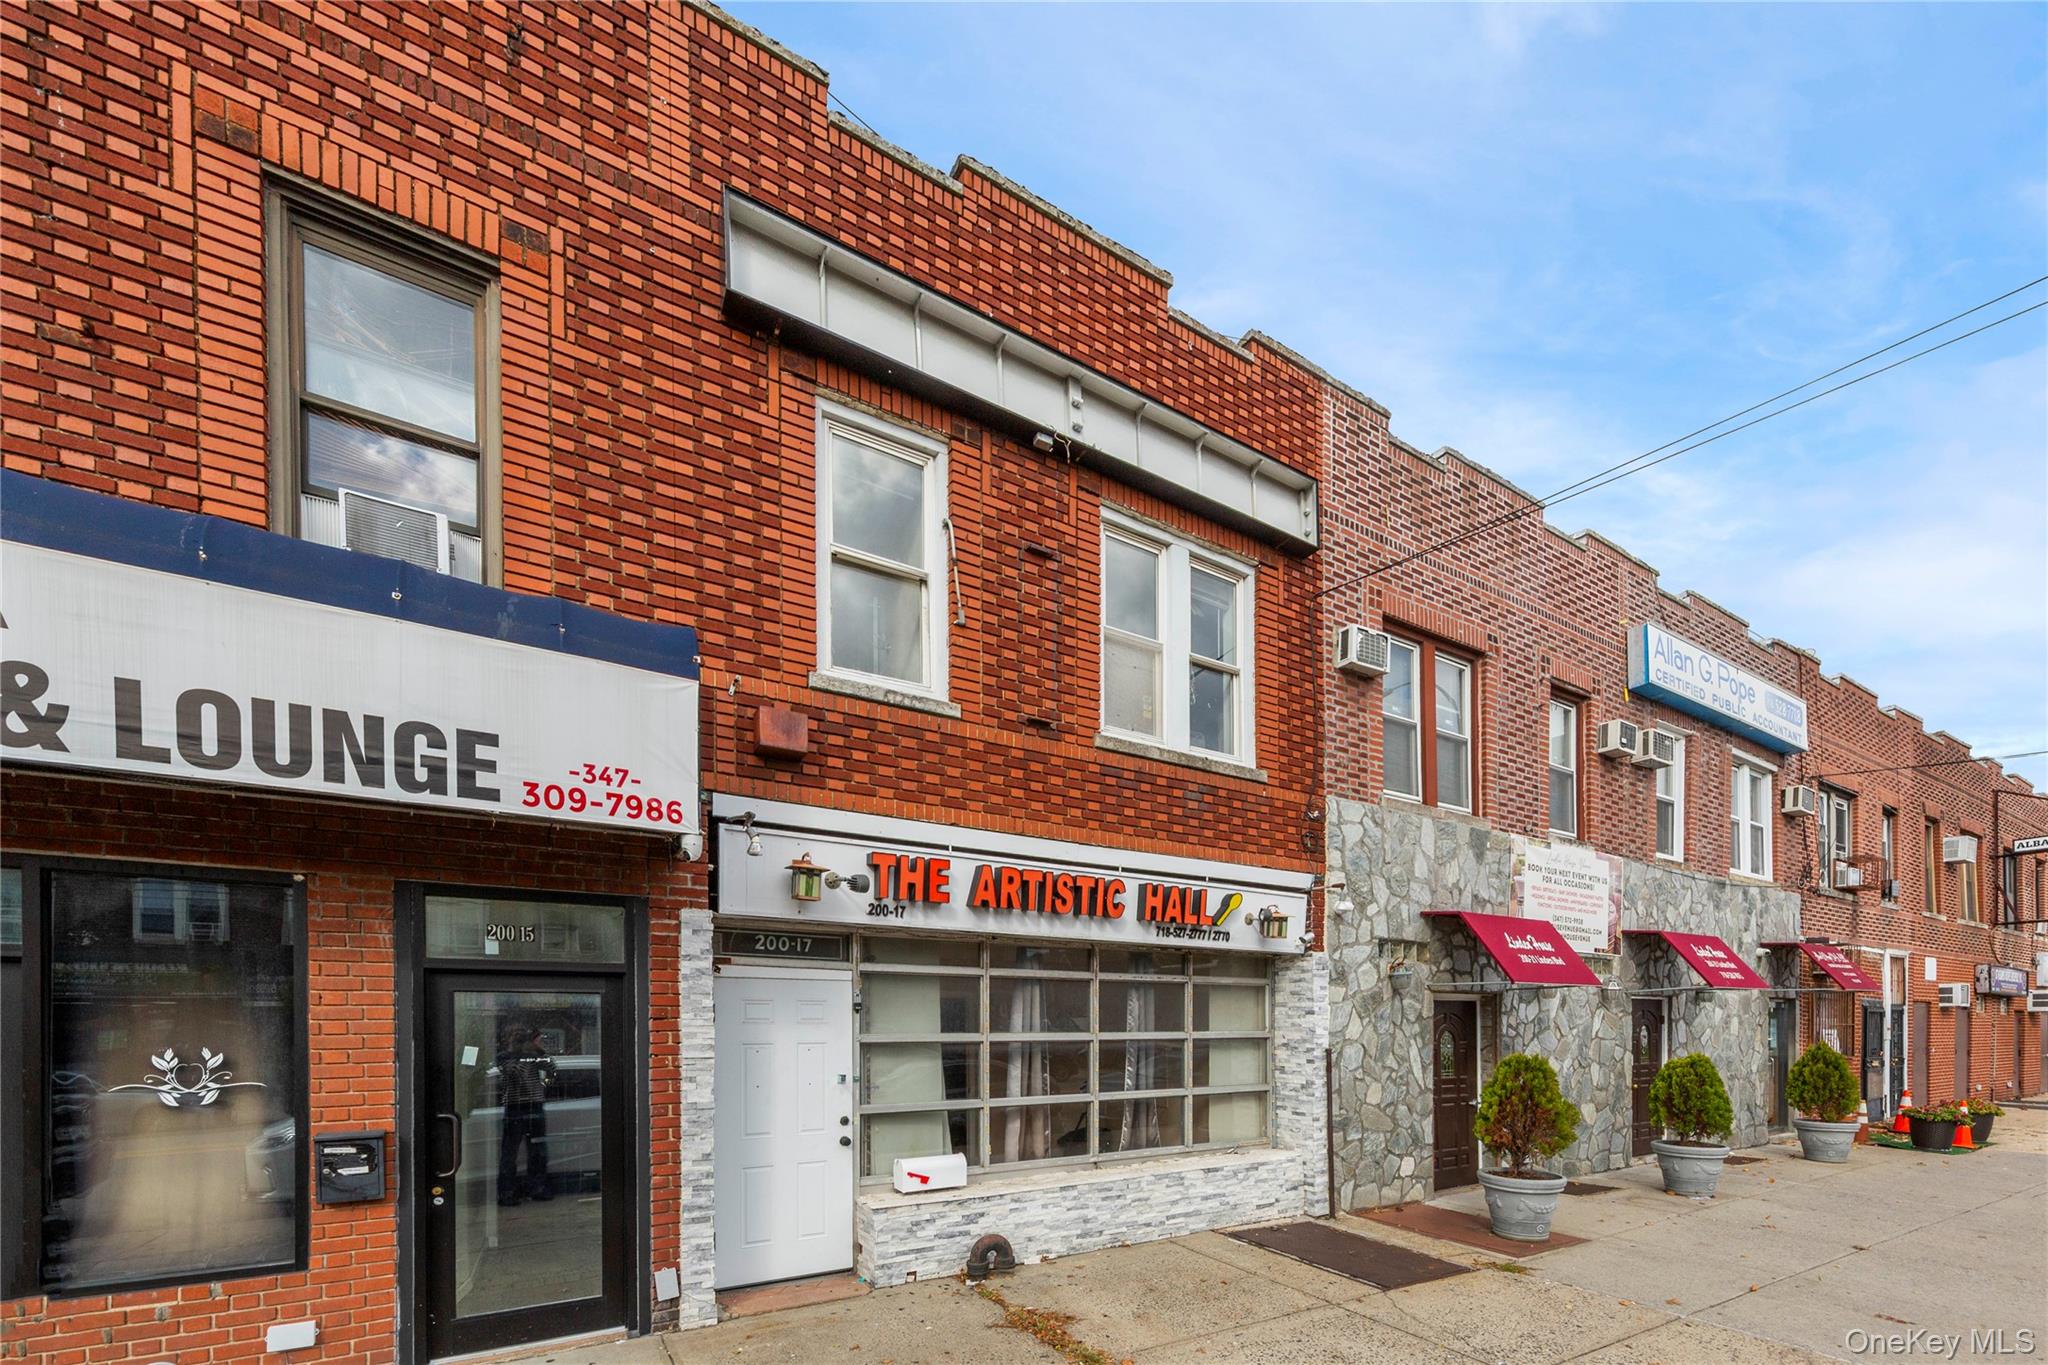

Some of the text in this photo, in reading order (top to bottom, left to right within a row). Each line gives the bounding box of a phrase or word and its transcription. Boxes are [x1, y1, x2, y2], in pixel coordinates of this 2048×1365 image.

[1654, 633, 1756, 704] Allan G. Pope
[1655, 668, 1706, 700] CERTIFIED
[1712, 693, 1746, 718] PUBLIC
[1752, 712, 1802, 744] ACCOUNTANT
[0, 660, 501, 803] & LOUNGE
[569, 763, 641, 788] -347-
[522, 781, 683, 824] 309-7986
[1527, 863, 1608, 885] BOOK YOUR NEXT EVENT WITH US
[1542, 875, 1552, 884] FOR
[1553, 877, 1563, 886] ALL
[867, 851, 1213, 926] THE ARTISTIC HALL
[867, 903, 906, 919] 200-17
[487, 924, 534, 942] 200 15
[754, 934, 812, 953] 200-17
[1156, 926, 1207, 940] 718-527-2777
[1212, 930, 1231, 942] 2770
